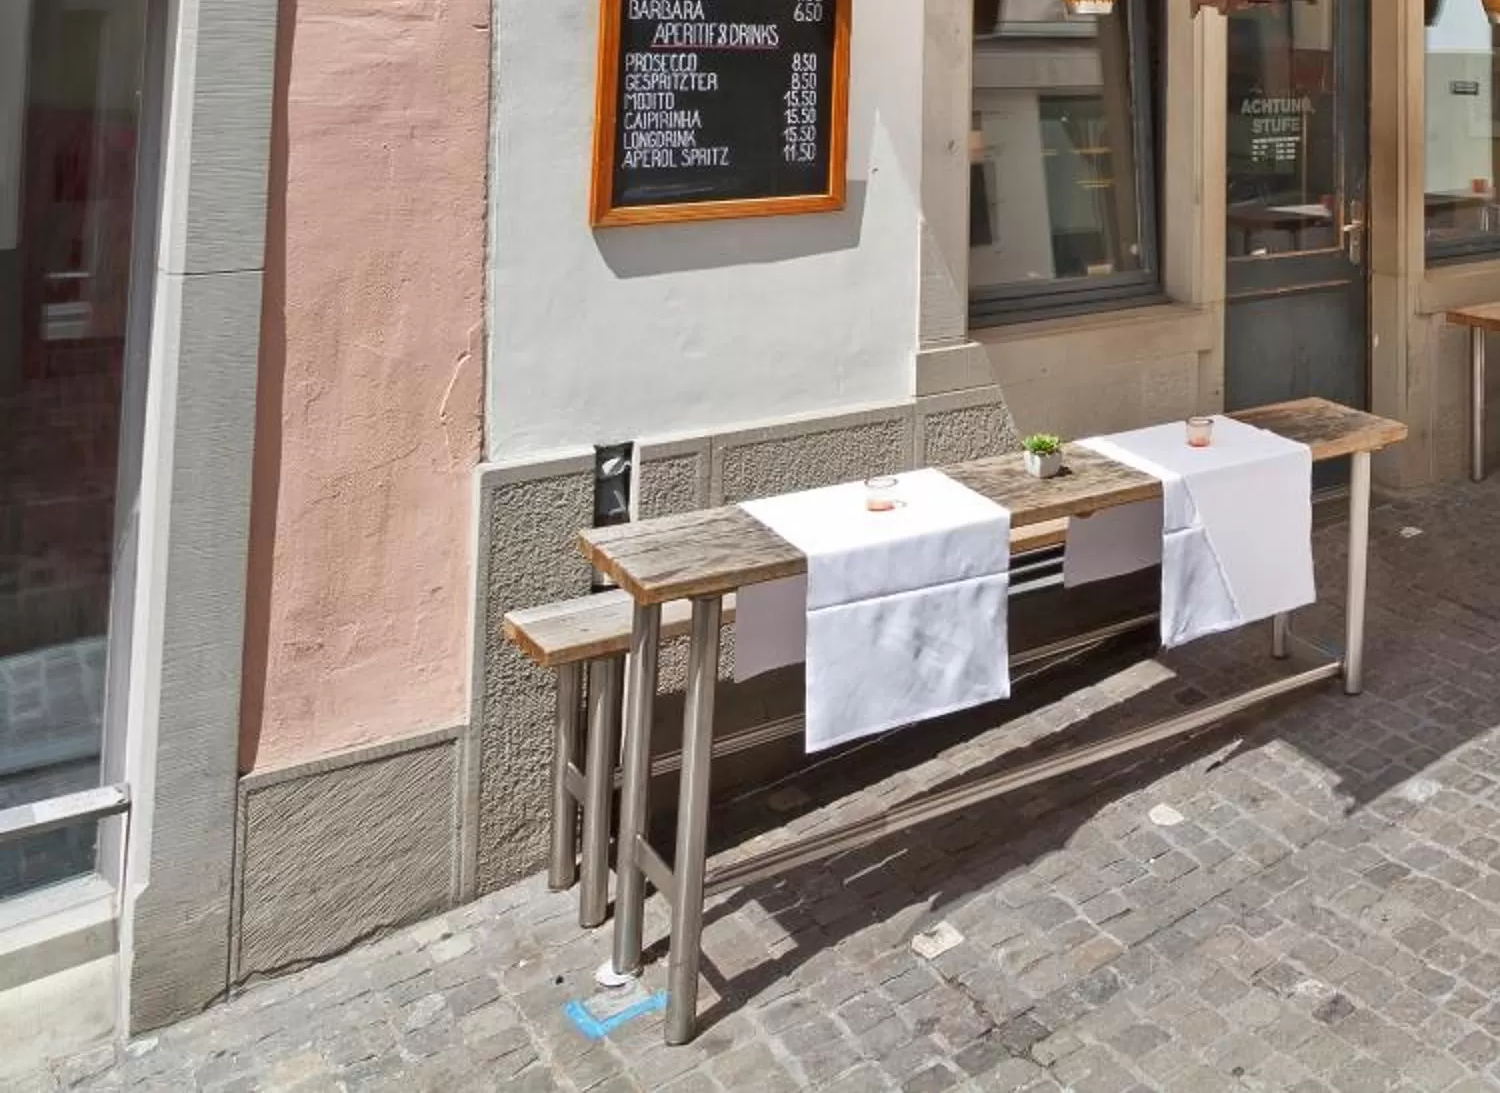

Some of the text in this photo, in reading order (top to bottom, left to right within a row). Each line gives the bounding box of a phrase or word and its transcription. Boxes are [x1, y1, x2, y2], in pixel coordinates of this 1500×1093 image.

[625, 52, 817, 72] PROSECCO 8.50
[625, 73, 719, 92] GESPRITZTER
[624, 90, 817, 110] MOJITO 15.50
[624, 108, 817, 130] CAIPIRINHA 15.50
[1251, 117, 1301, 134] STUFE
[623, 125, 817, 150] LONGDRINK 15.50
[622, 148, 678, 170] APEROL
[681, 146, 729, 167] SPRITZ
